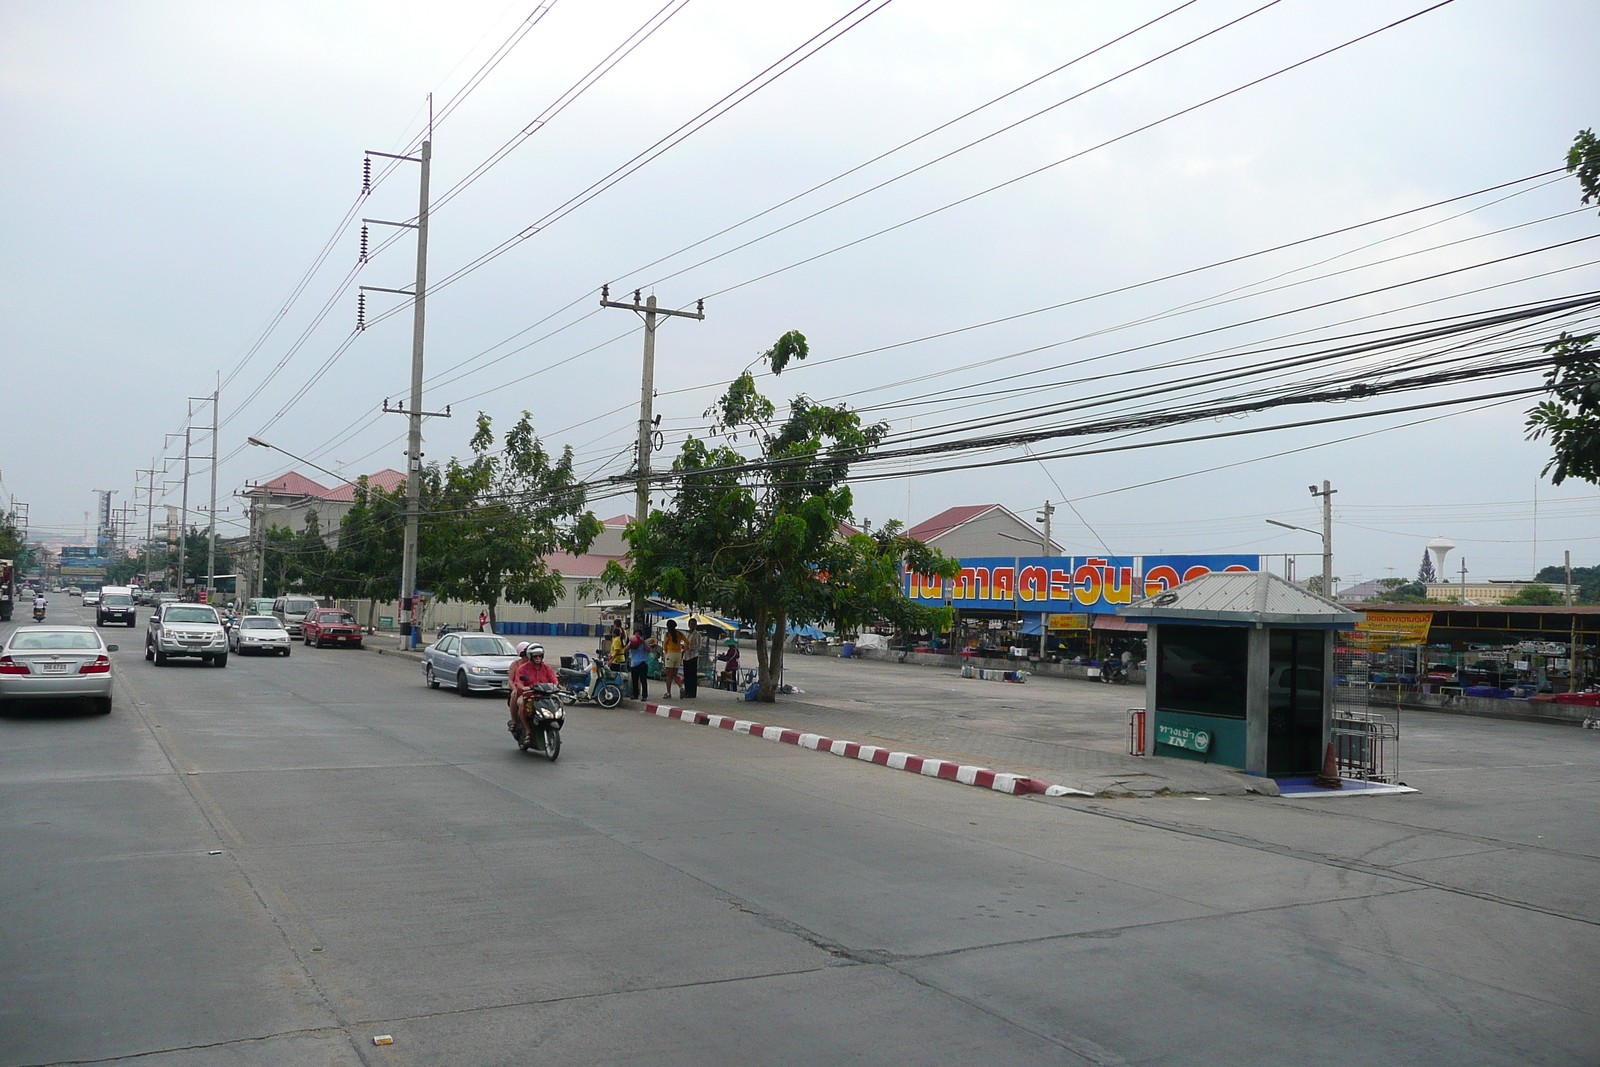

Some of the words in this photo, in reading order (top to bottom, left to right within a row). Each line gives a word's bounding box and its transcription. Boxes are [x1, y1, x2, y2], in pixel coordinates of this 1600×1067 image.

[1159, 725, 1195, 740] ทางเข้า
[1167, 735, 1188, 748] IN
